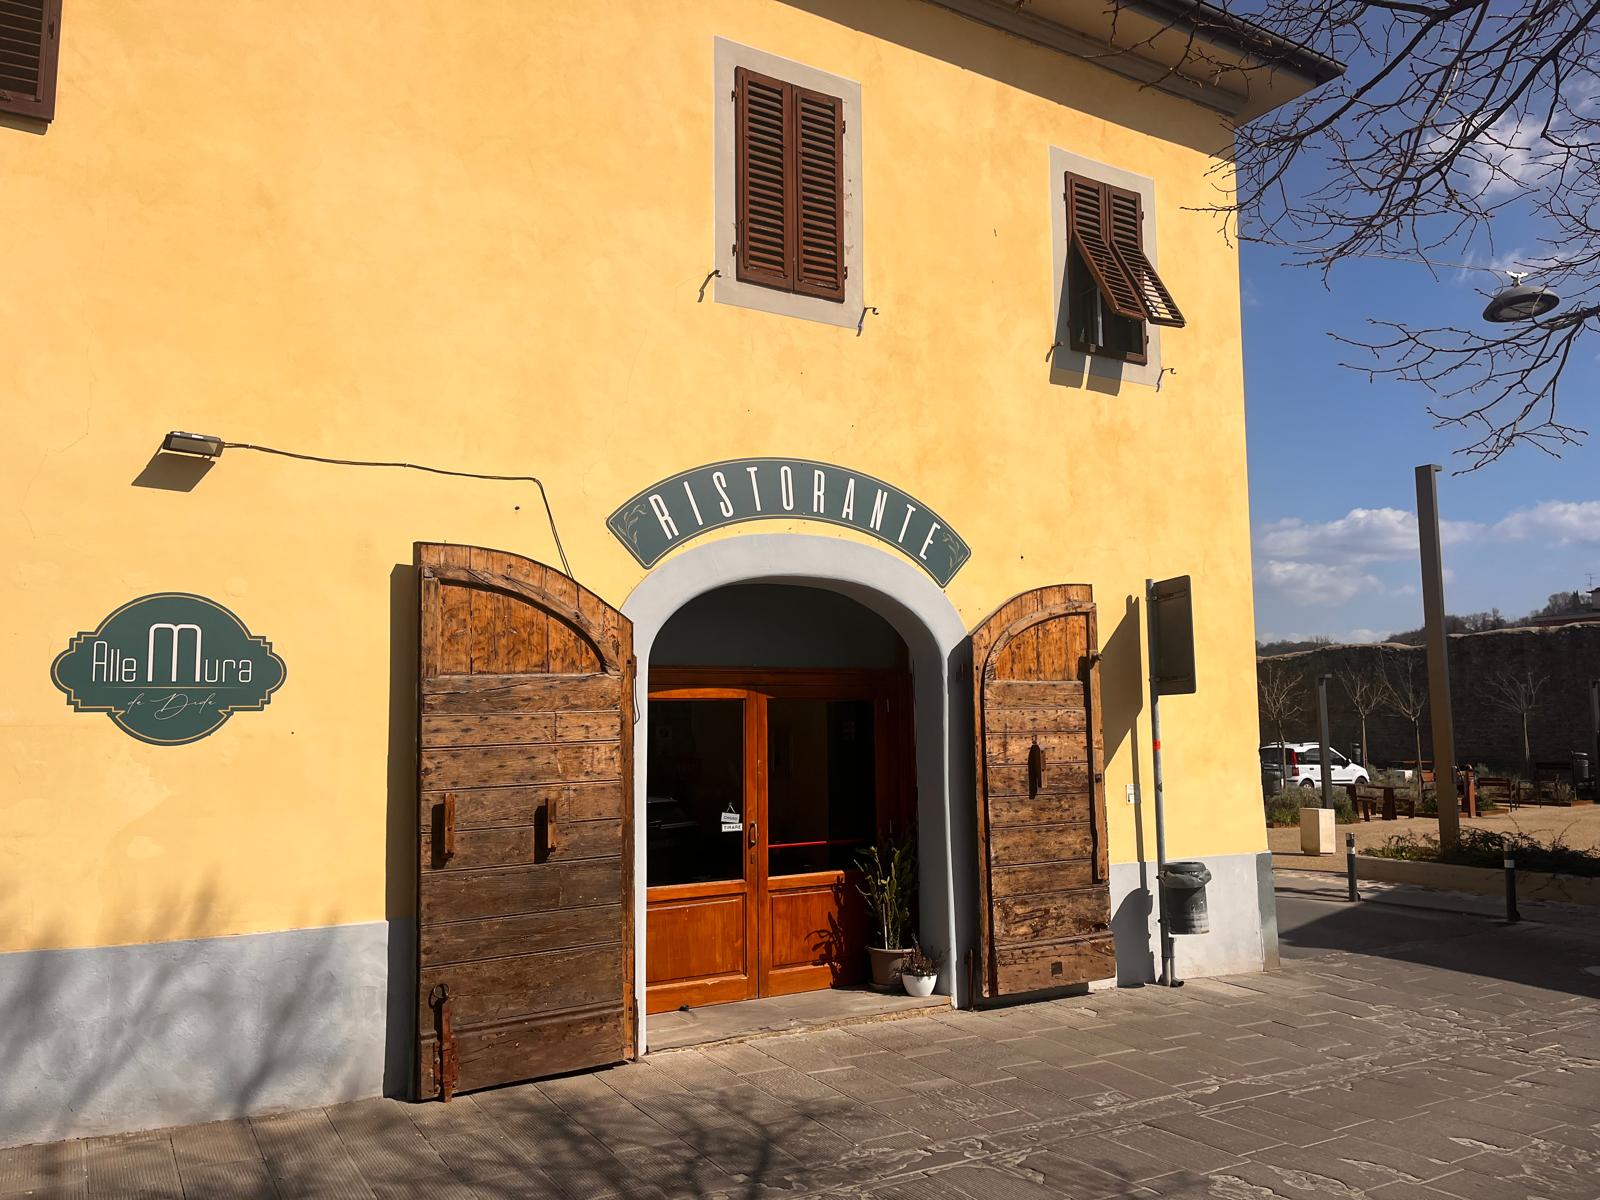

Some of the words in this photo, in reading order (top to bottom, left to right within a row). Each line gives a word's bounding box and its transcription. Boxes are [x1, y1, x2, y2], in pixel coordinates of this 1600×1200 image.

[648, 465, 941, 561] RISTORANTE
[92, 640, 137, 683] Alle
[147, 623, 252, 683] Mura
